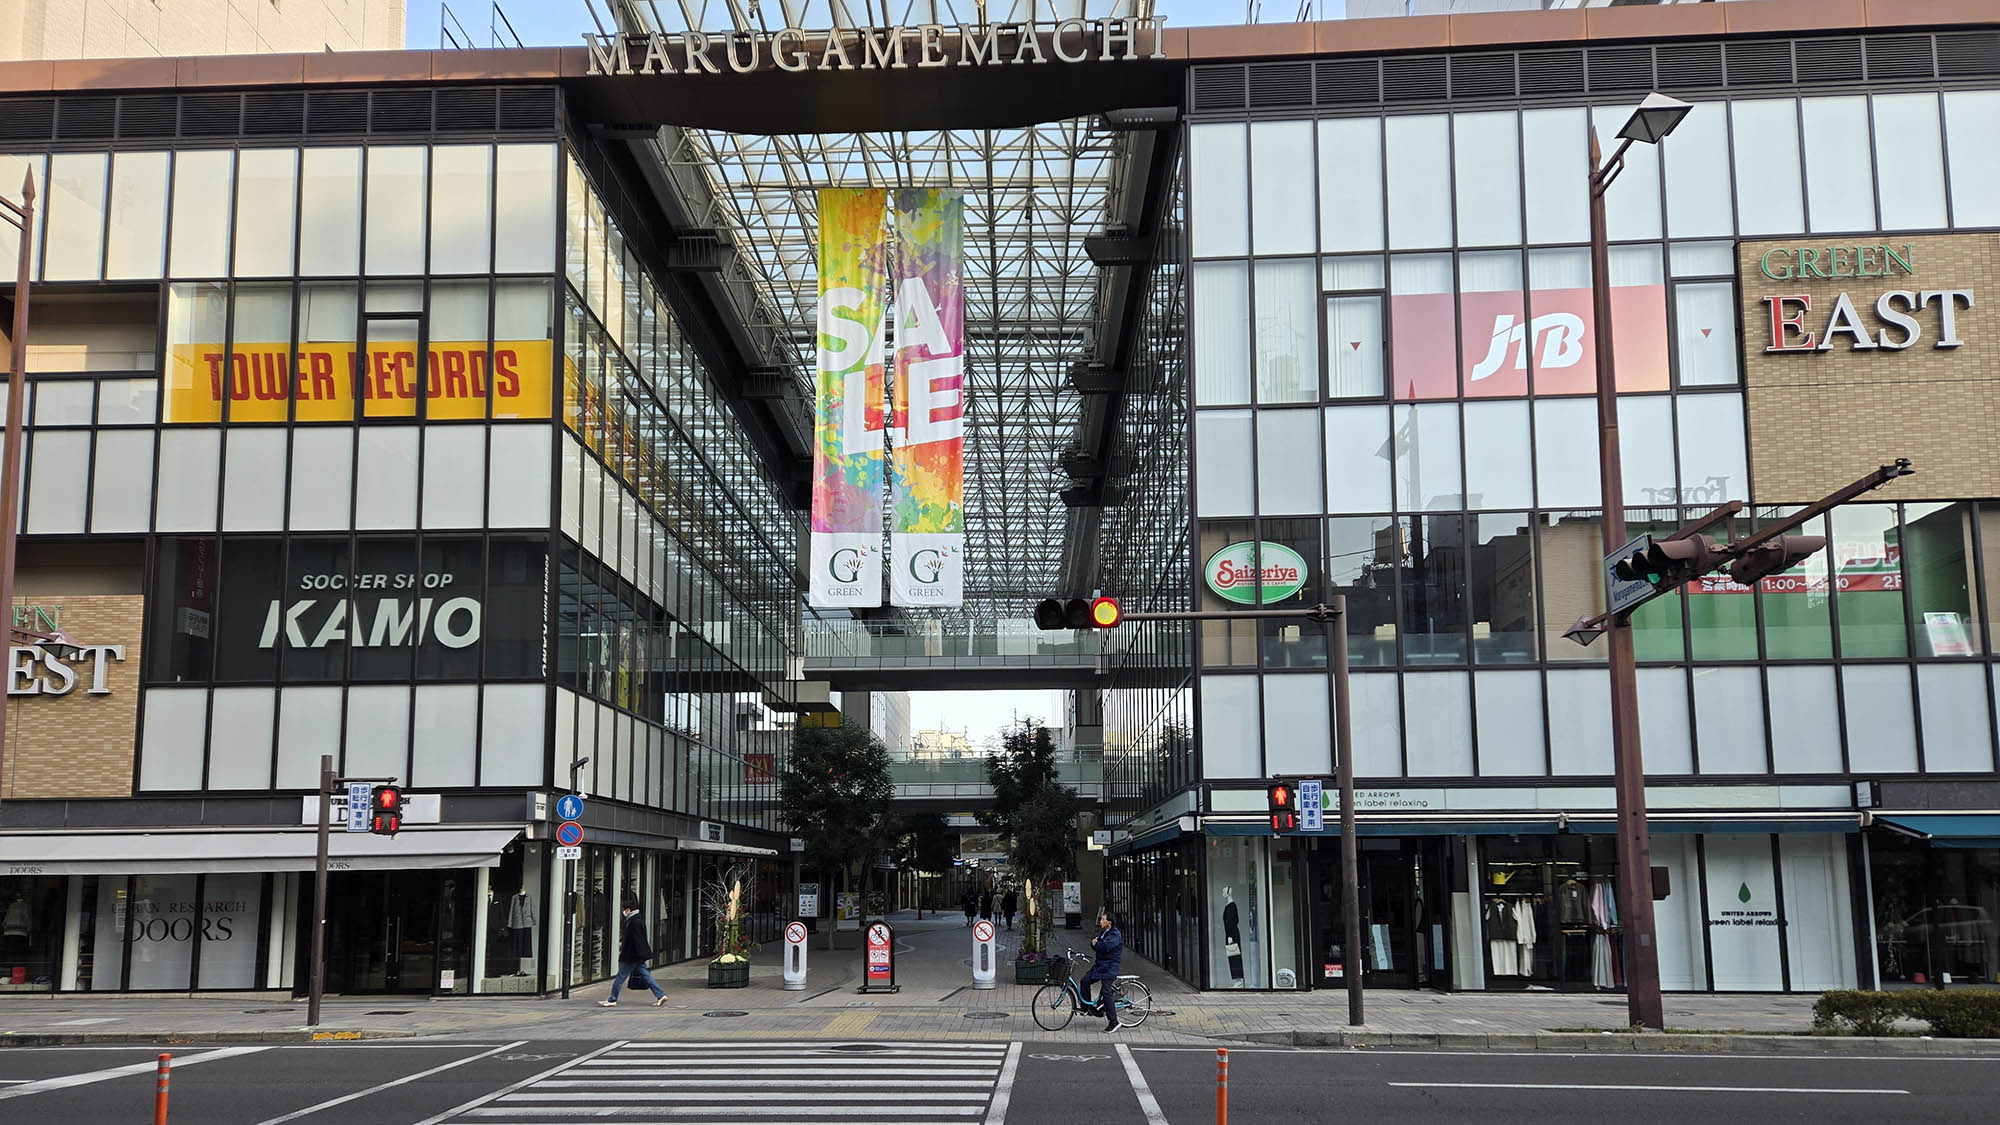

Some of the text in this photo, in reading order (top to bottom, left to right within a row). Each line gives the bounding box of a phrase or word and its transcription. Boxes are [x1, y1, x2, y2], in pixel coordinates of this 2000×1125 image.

[582, 15, 1168, 77] MARUGAMEMACHI
[1761, 243, 1915, 280] GREEN
[1763, 289, 1975, 354] EAST
[1470, 312, 1585, 382] JTB
[203, 349, 521, 401] TOWER RECORDS
[300, 574, 387, 590] SOCCER
[1216, 560, 1298, 585] Saizeriya
[828, 588, 863, 596] GREEN
[909, 588, 944, 597] GREEN
[258, 596, 481, 649] KAMO
[1364, 799, 1387, 807] label
[1390, 799, 1428, 808] relaxing
[168, 901, 247, 913] RESARCH
[120, 917, 233, 942] DOORS
[1732, 918, 1753, 926] label
